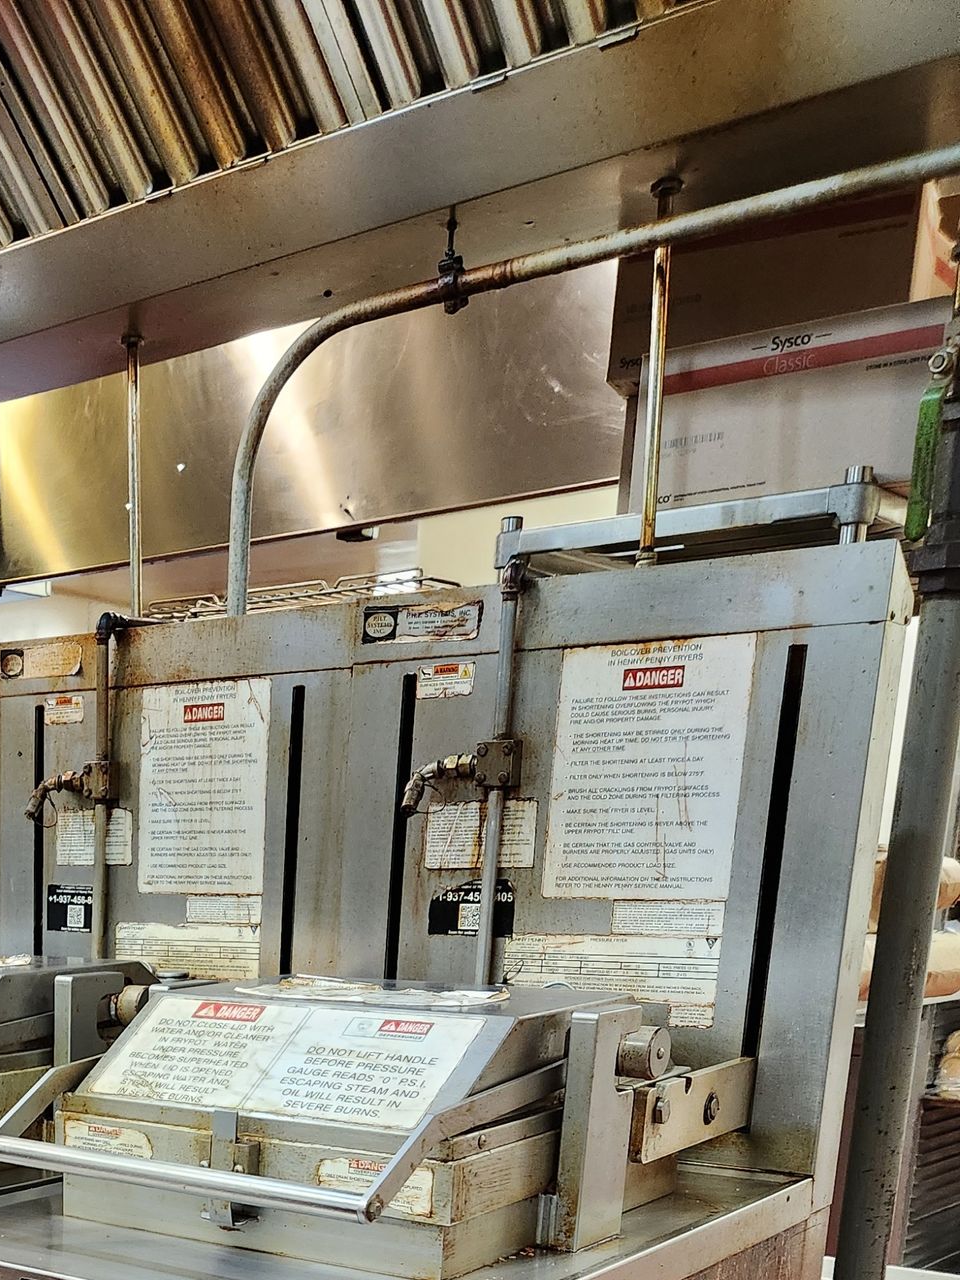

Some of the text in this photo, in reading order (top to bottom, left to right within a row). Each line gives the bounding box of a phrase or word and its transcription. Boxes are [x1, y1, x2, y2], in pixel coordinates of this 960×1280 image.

[771, 334, 811, 352] Sysco
[620, 357, 642, 369] Sysc
[763, 354, 815, 374] Classic
[653, 643, 701, 653] PREVENTION
[673, 653, 703, 661] FRYERS
[635, 668, 683, 686] DANGER
[192, 706, 223, 720] DANGER
[215, 1005, 262, 1019] DANGER
[158, 1017, 174, 1025] DO
[195, 1020, 229, 1029] CLOSE
[248, 1024, 275, 1032] WITH
[396, 1022, 431, 1032] DANGER
[150, 1026, 183, 1034] WATER
[222, 1032, 271, 1041] CLEANER
[128, 1051, 249, 1068] BECOMES SUPERHEATED
[187, 1048, 240, 1057] PRESSURE
[306, 1046, 439, 1064] DO NOT LIFT HANDLE
[130, 1061, 159, 1069] WHEN
[303, 1058, 425, 1075] BEFORE PRESSURE
[121, 1069, 171, 1079] ESCAPING
[172, 1074, 206, 1082] WATER
[286, 1067, 330, 1076] GAUGE
[331, 1071, 375, 1081] READS
[120, 1079, 153, 1087] STEAM
[178, 1085, 216, 1094] RESULT
[278, 1077, 420, 1098] ESCAPING STEAM AND
[281, 1088, 301, 1096] OIL
[304, 1091, 334, 1100] WILL
[335, 1095, 385, 1105] RESULT
[282, 1100, 383, 1117] SEVERE BURNS.
